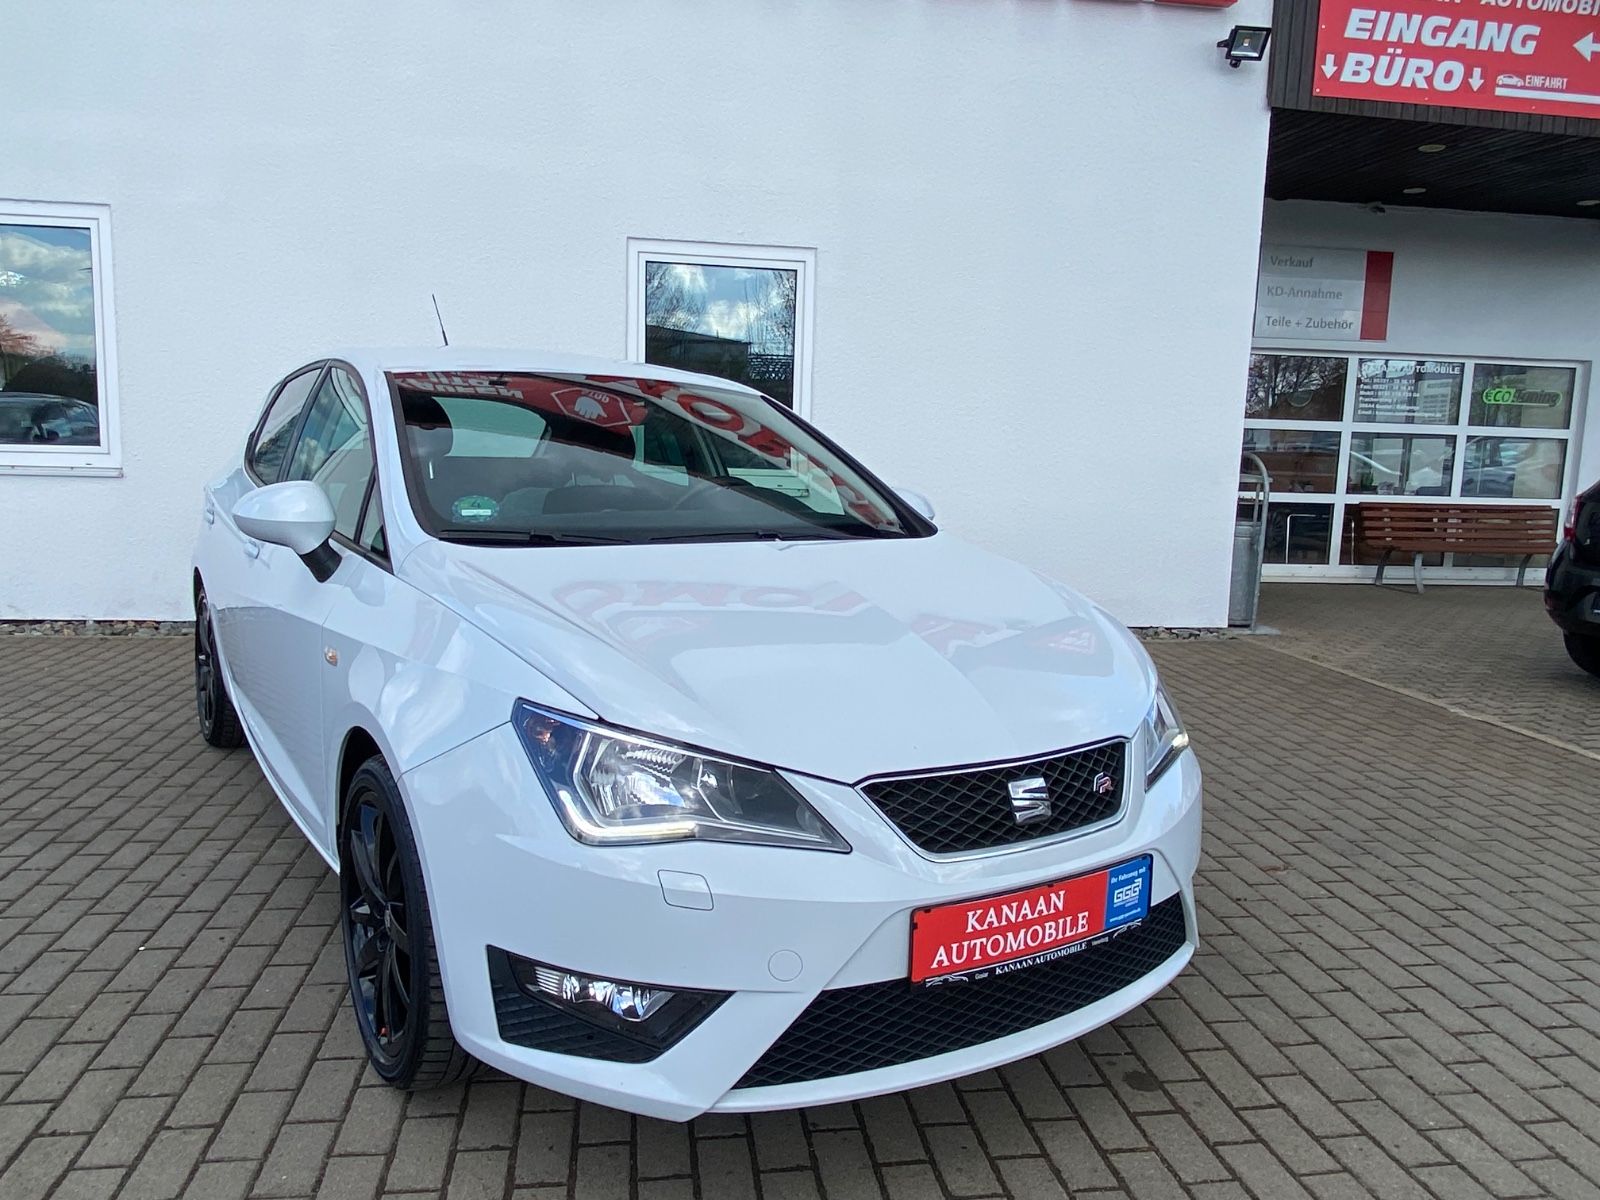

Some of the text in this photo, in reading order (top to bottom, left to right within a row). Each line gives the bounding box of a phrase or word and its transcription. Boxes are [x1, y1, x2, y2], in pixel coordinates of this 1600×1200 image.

[1344, 8, 1541, 55] EINGANG
[1339, 48, 1464, 92] BÜRO
[1525, 74, 1568, 90] EINFAHRT
[1270, 256, 1314, 268] Verkauf
[1267, 286, 1343, 300] KD-Annahme
[1265, 316, 1292, 327] Teile
[1305, 317, 1354, 330] Zubehör
[965, 890, 1067, 934] KANAAN
[930, 911, 1089, 969] AUTOMOBILE
[995, 958, 1034, 975] KANAAN
[1035, 942, 1088, 965] AUTOMOBILE
